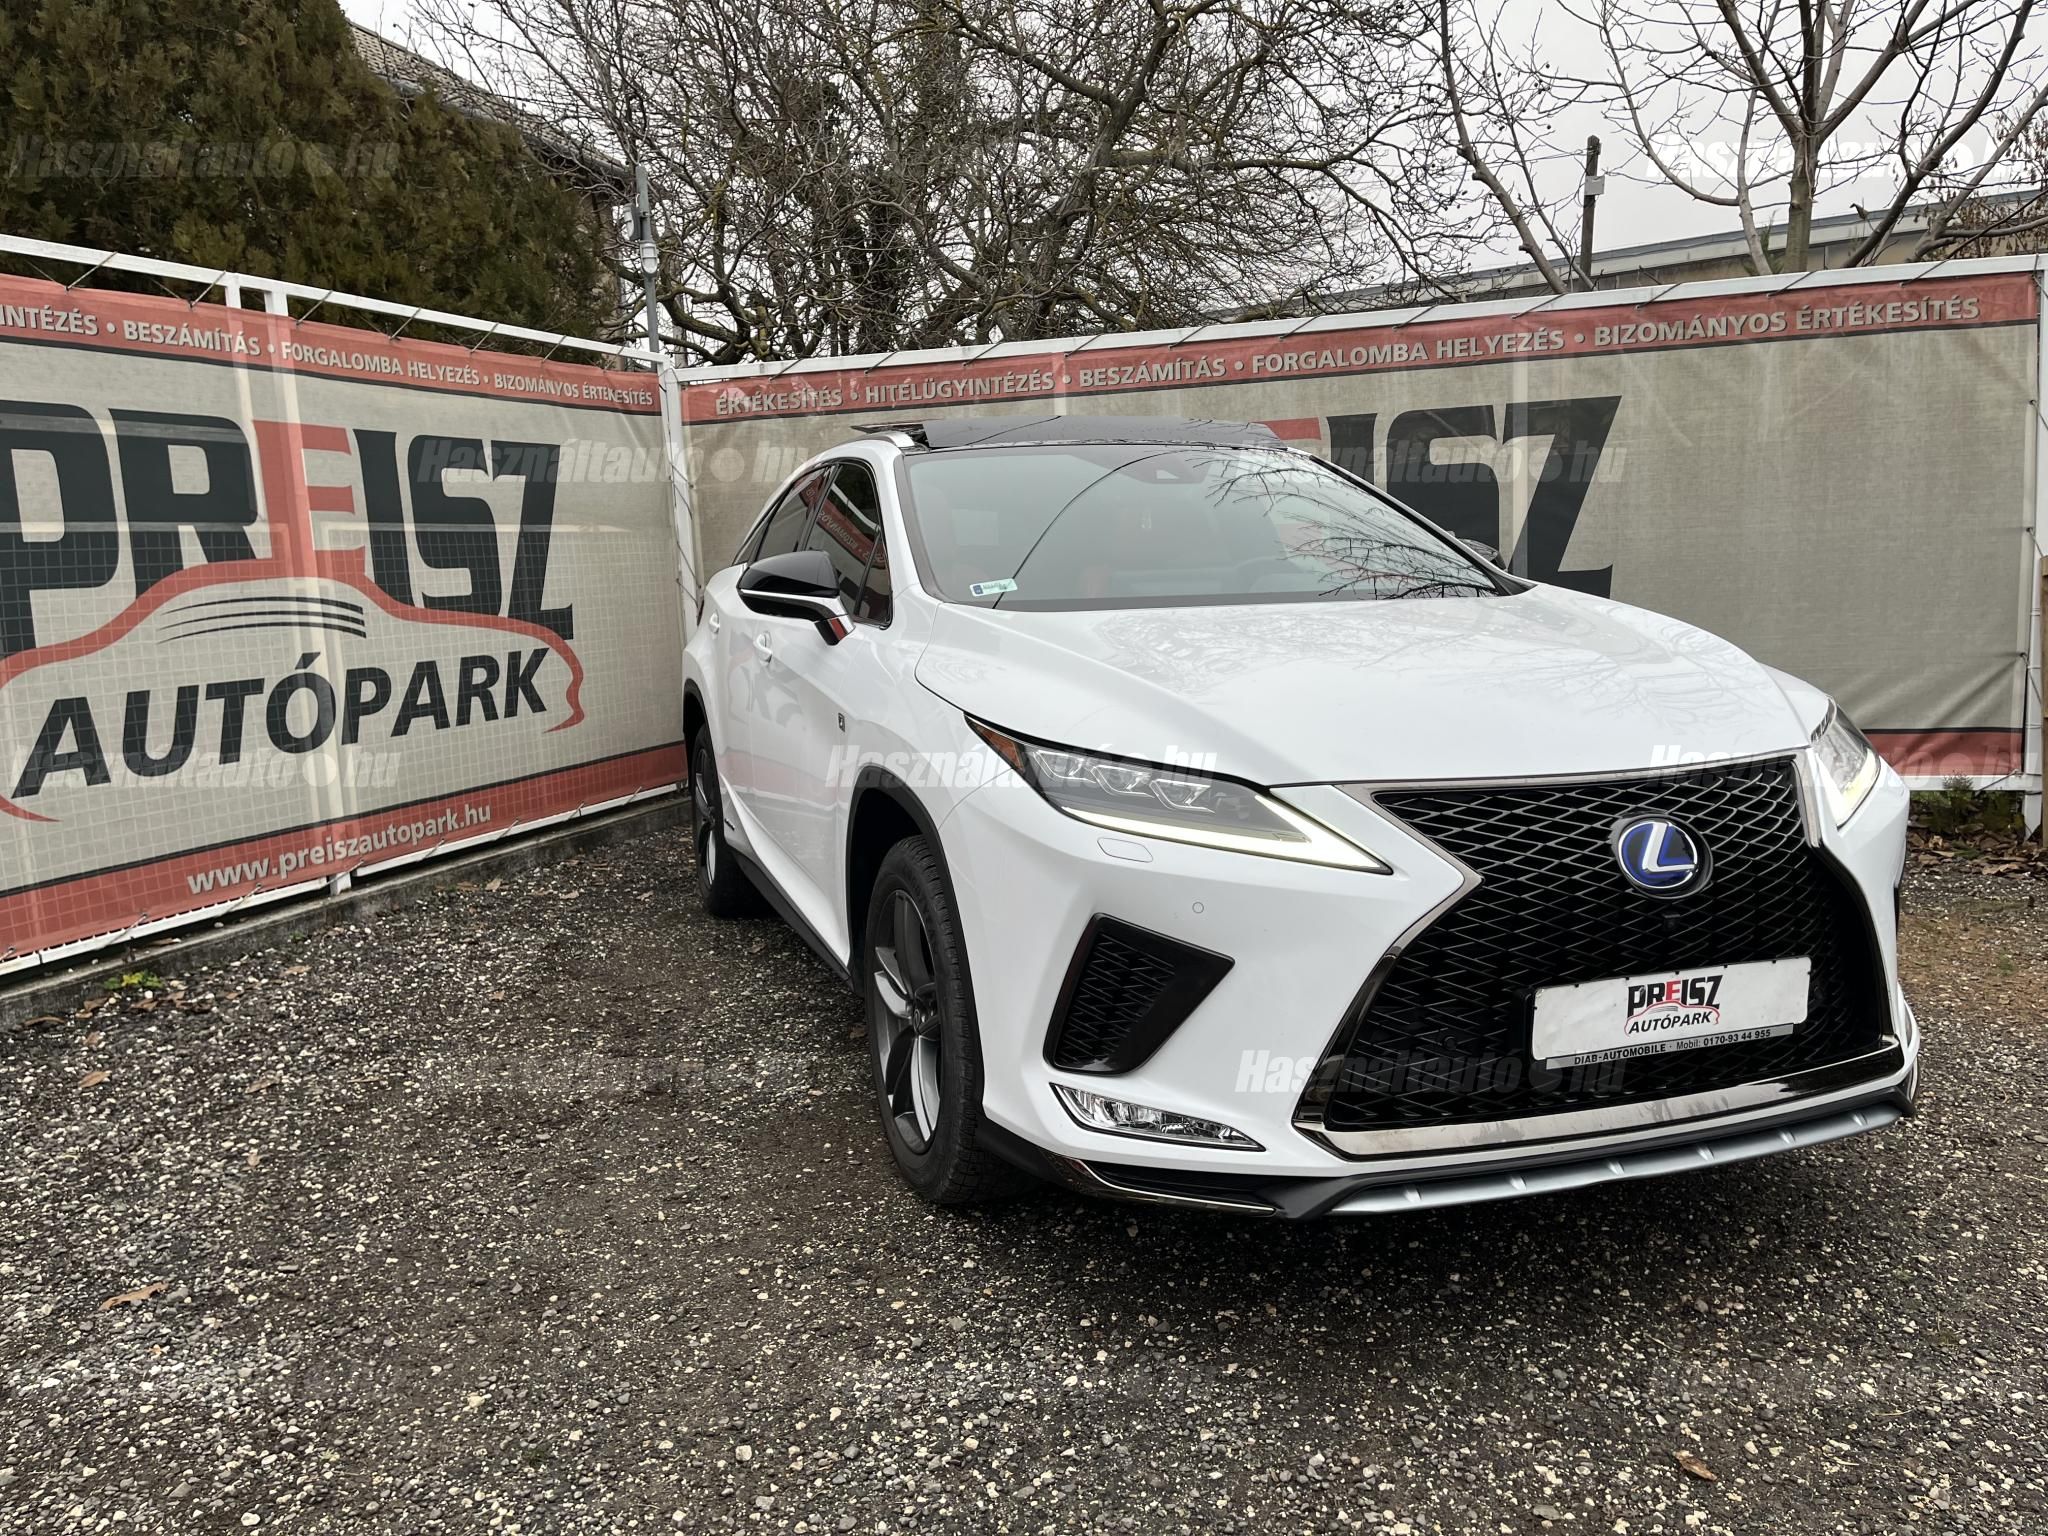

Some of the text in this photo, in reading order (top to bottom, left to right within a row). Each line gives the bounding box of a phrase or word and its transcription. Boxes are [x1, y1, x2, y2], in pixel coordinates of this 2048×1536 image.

[123, 319, 261, 356] BESZÁMÍTÁS
[281, 341, 404, 376] FORGALOMBA
[408, 360, 480, 385] HELYEZÉS
[494, 373, 579, 398] BIZOMÁNYOS
[715, 385, 843, 416] ÉRTÉKESÍTÉS
[1079, 356, 1227, 388] BESZÁMÍTÁS
[1252, 341, 1430, 374] FORGALOMBA
[1436, 327, 1565, 360] HELYEZÉS
[1594, 310, 1787, 347] BIZOMÁNYOS
[1796, 296, 1980, 331] ÉRTÉKESÍTÉS
[0, 401, 574, 658] PREISZ
[11, 651, 550, 799] AUTÓPARK
[187, 803, 491, 895] www.preiszautopark.hu
[1627, 975, 1723, 1019] PREISZ
[1628, 1011, 1713, 1034] AUTÓPARK
[1574, 1043, 1666, 1065] DIAB-AUTOMOBILE
[1703, 1034, 1739, 1046] 0170-93
[1741, 1031, 1752, 1040] 44
[1754, 1029, 1771, 1039] 955
